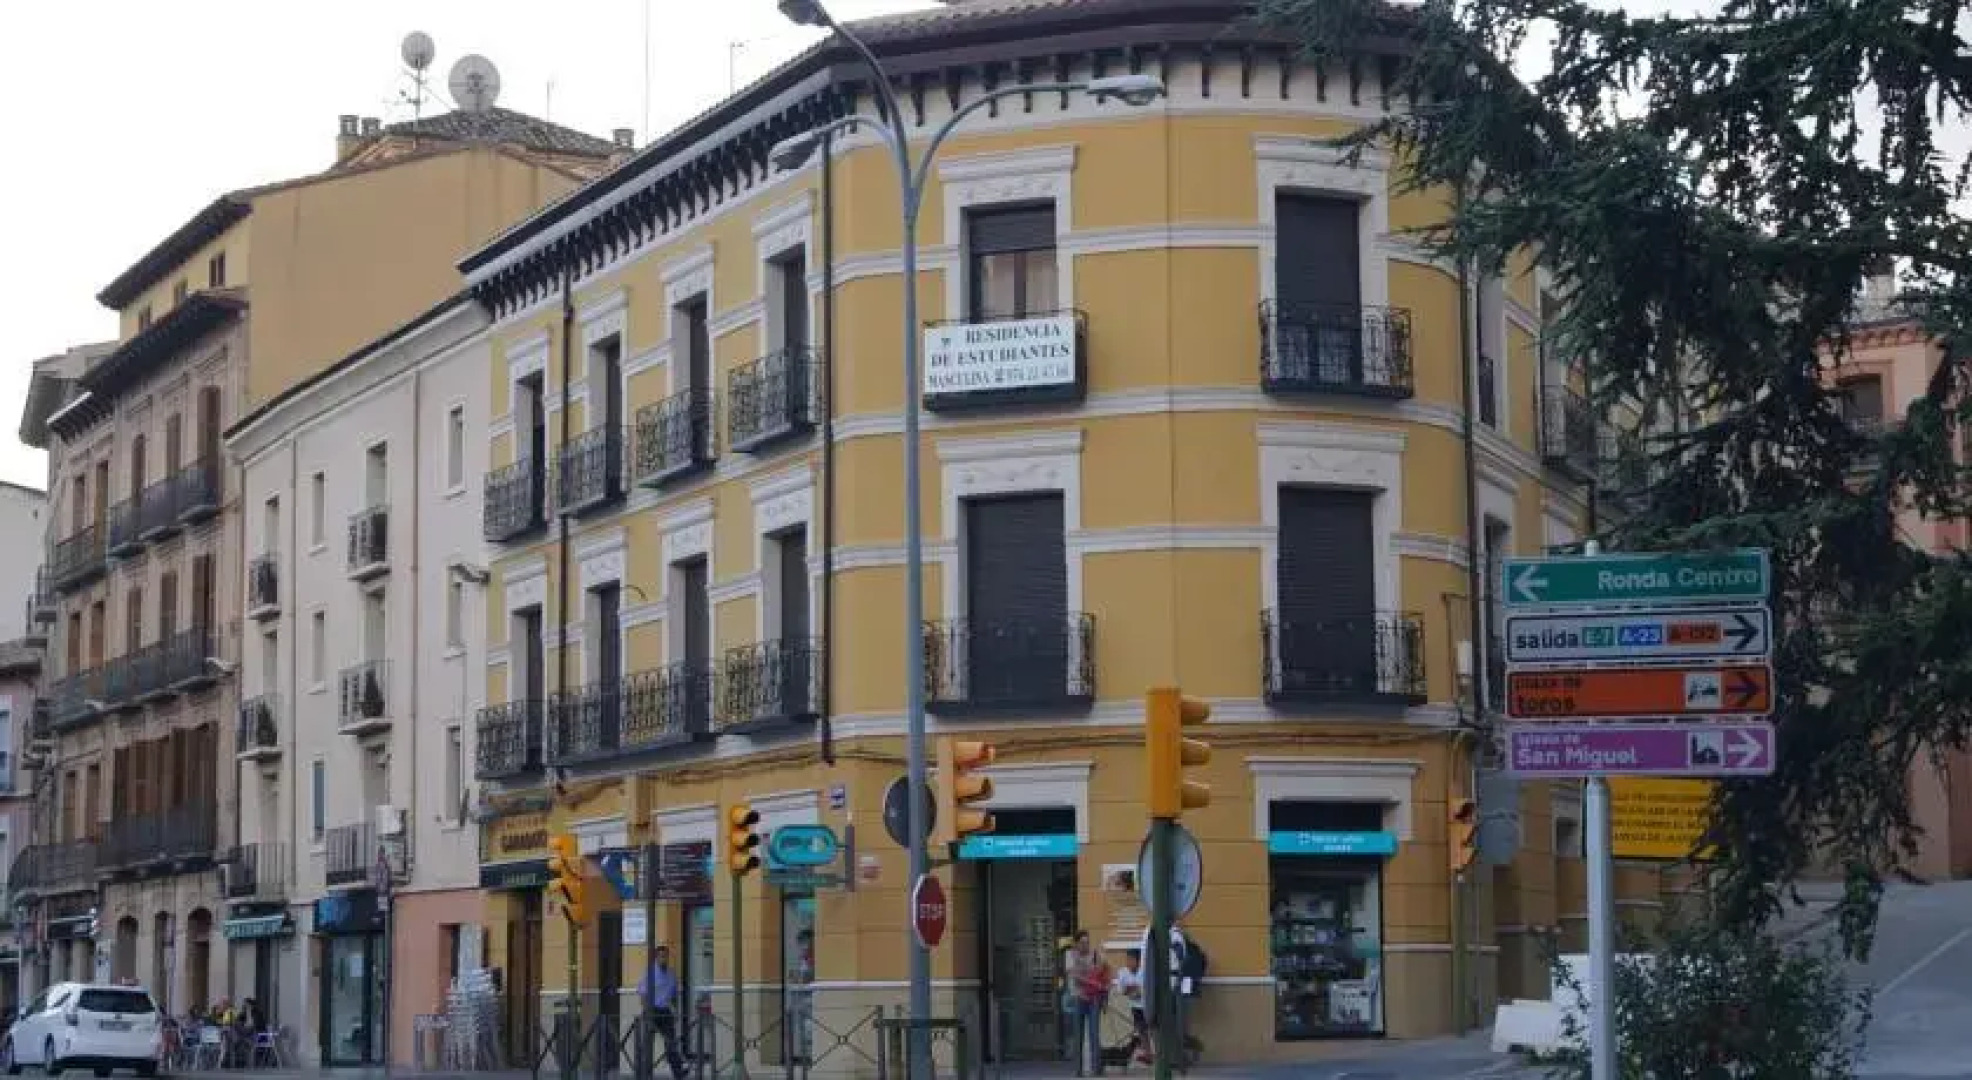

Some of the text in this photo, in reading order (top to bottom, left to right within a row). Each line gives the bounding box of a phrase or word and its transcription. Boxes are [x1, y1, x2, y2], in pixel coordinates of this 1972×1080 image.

[966, 323, 1061, 343] RESIDENCIA
[931, 344, 1070, 367] DE ESTUDIANTES
[1598, 566, 1758, 590] Ronda Centro
[1516, 628, 1579, 649] salida
[1518, 744, 1636, 769] San Miguel
[920, 903, 945, 921] STOP
